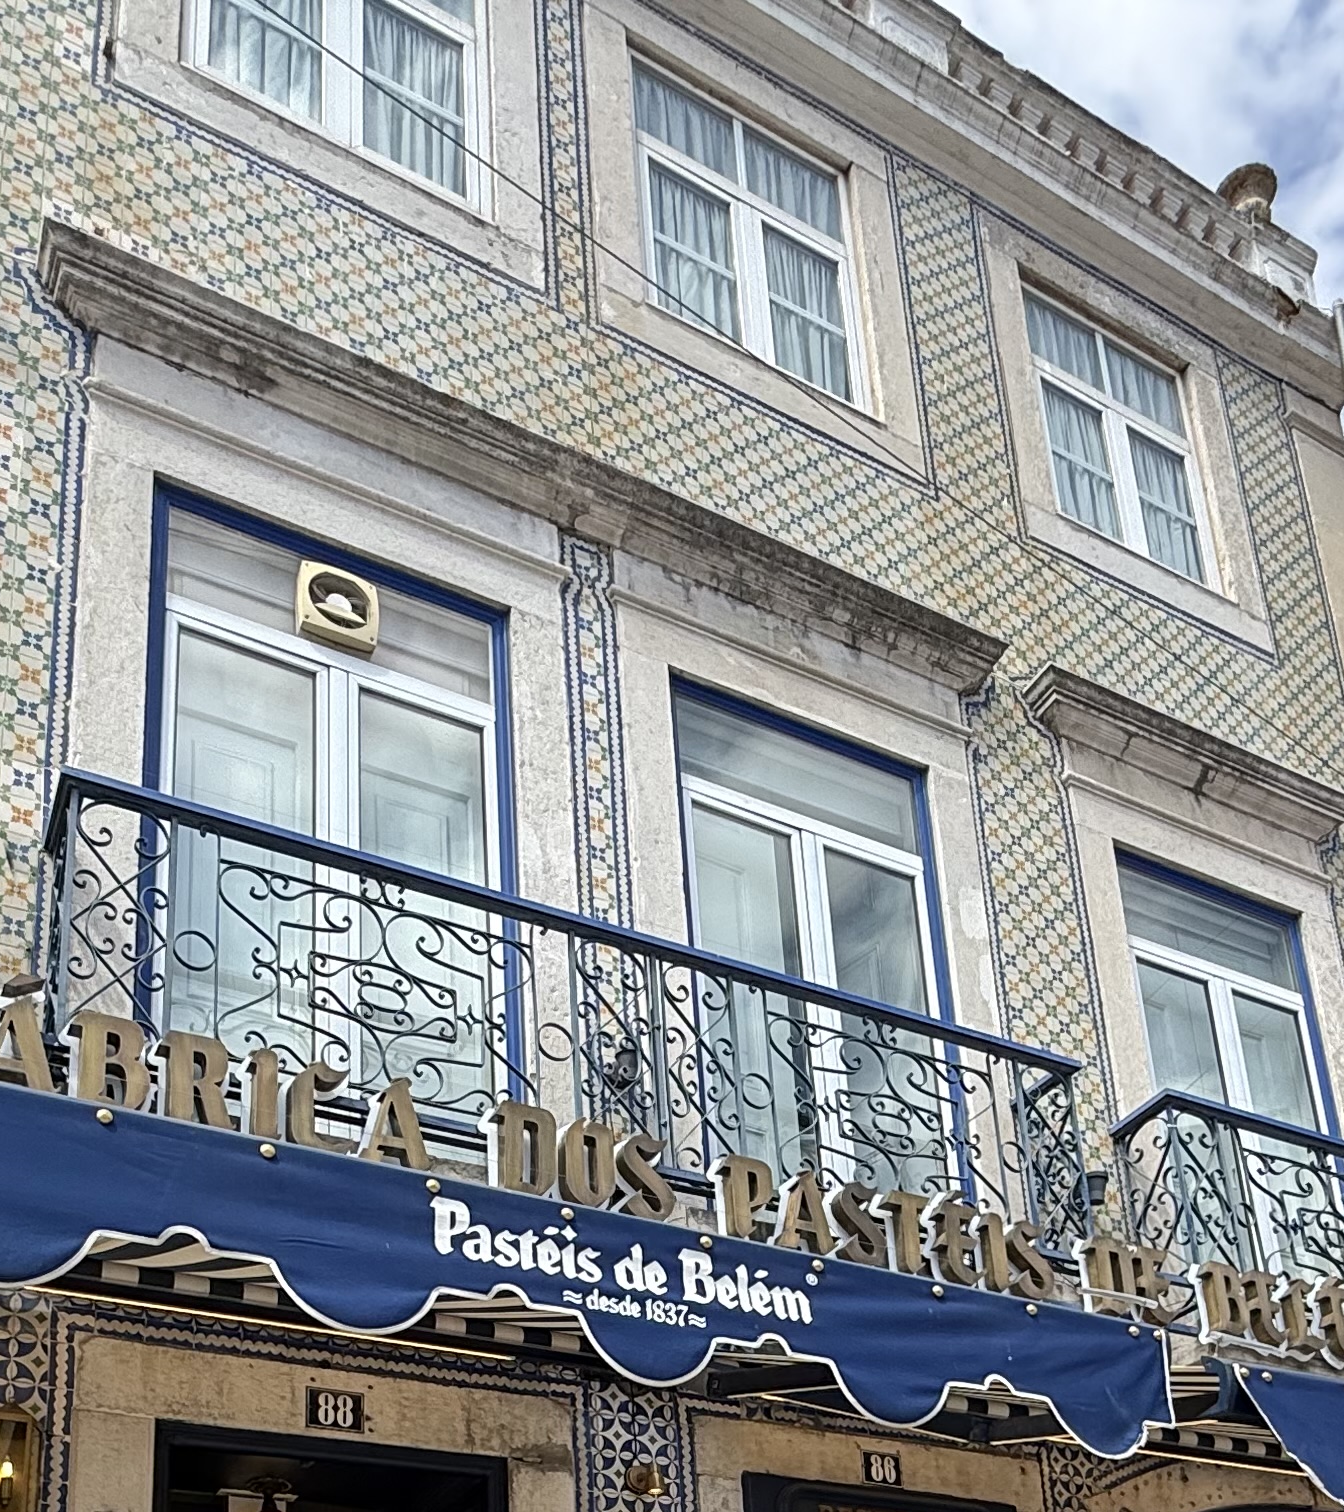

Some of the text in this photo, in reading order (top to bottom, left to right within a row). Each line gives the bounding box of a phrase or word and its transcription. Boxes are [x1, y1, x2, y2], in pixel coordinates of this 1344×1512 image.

[490, 1099, 677, 1221] DOS
[714, 1153, 1055, 1301] PASTÉIS
[429, 1195, 814, 1325] Pastéis de Belém
[585, 1287, 690, 1327] desde 1837
[317, 1392, 354, 1428] 88
[869, 1453, 897, 1485] 86
